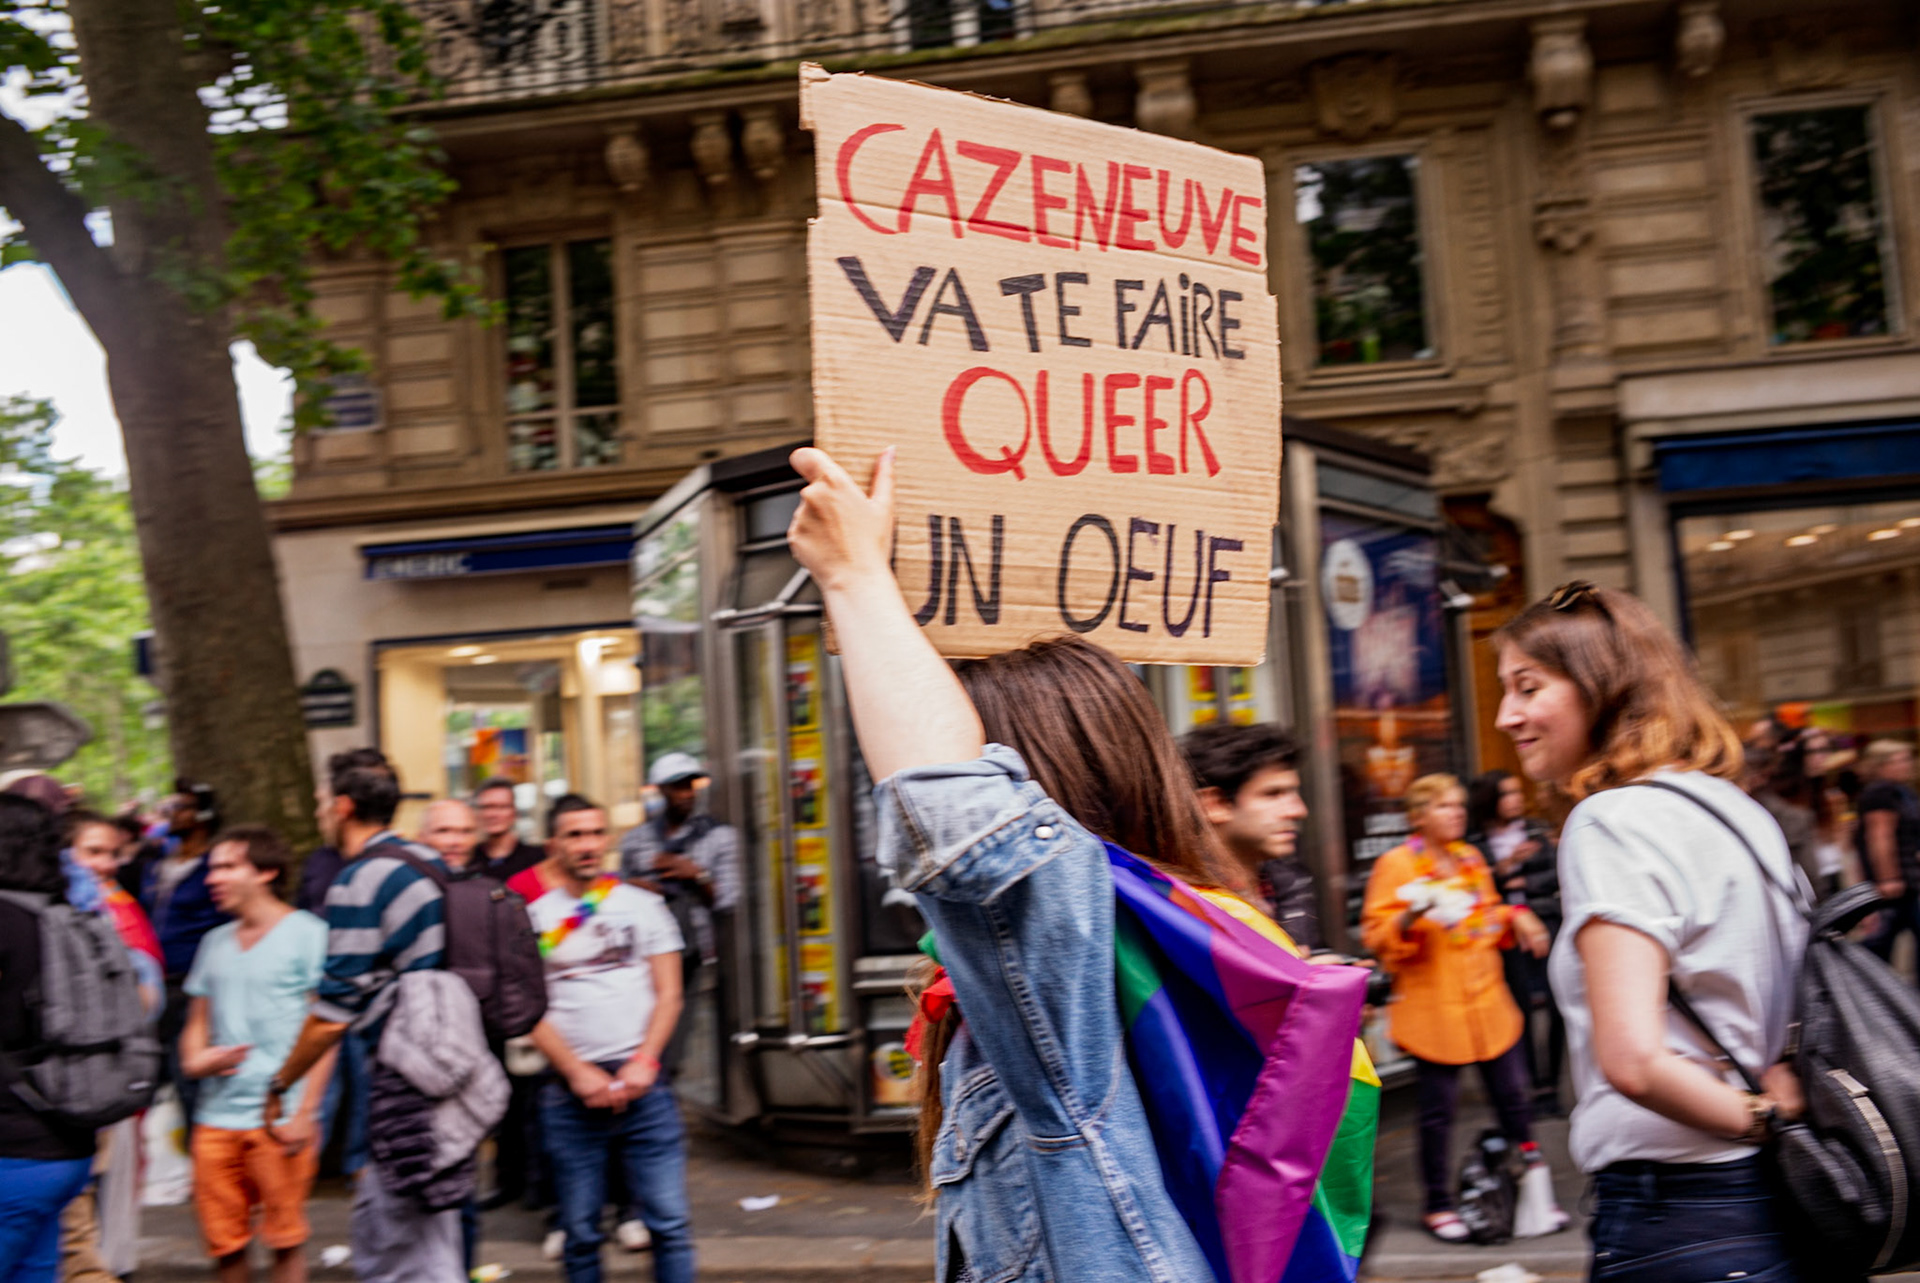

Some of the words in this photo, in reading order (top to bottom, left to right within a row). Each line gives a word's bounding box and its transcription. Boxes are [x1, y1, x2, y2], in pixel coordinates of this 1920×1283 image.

[836, 123, 1263, 266] CAZENEUVE
[836, 256, 990, 352] VA
[999, 272, 1092, 353] TE
[942, 366, 1221, 481] QUEER
[891, 514, 1005, 627] UN
[1057, 513, 1244, 638] OEUF
